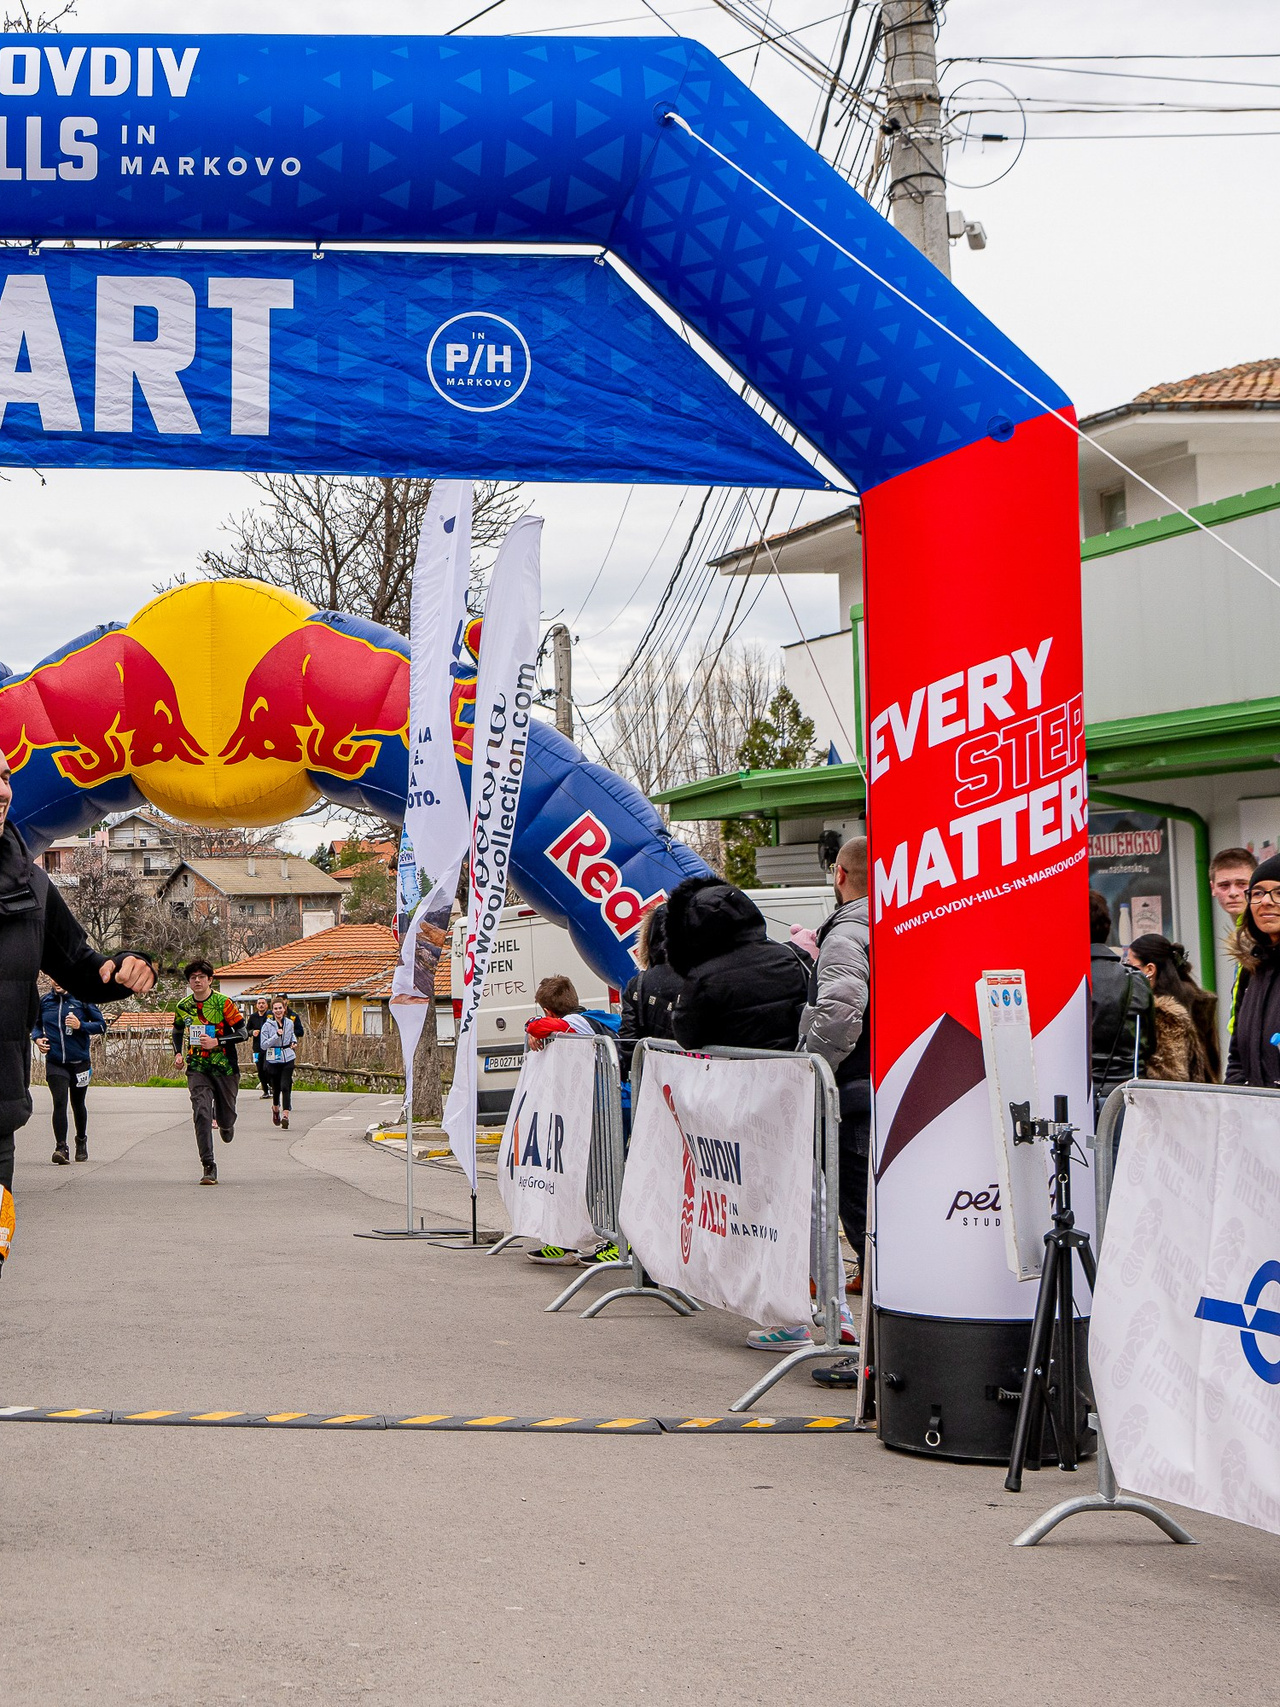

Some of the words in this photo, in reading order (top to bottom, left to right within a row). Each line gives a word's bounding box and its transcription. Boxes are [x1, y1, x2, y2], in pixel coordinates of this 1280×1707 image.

[121, 125, 156, 145] IN
[121, 156, 303, 177] MARKOVO
[471, 331, 486, 340] IN
[445, 343, 512, 376] P/H
[445, 378, 512, 388] MARKOVO
[870, 636, 1054, 786] EVERY
[954, 691, 1085, 810] STEP
[547, 813, 667, 938] Red
[728, 1202, 739, 1217] IN
